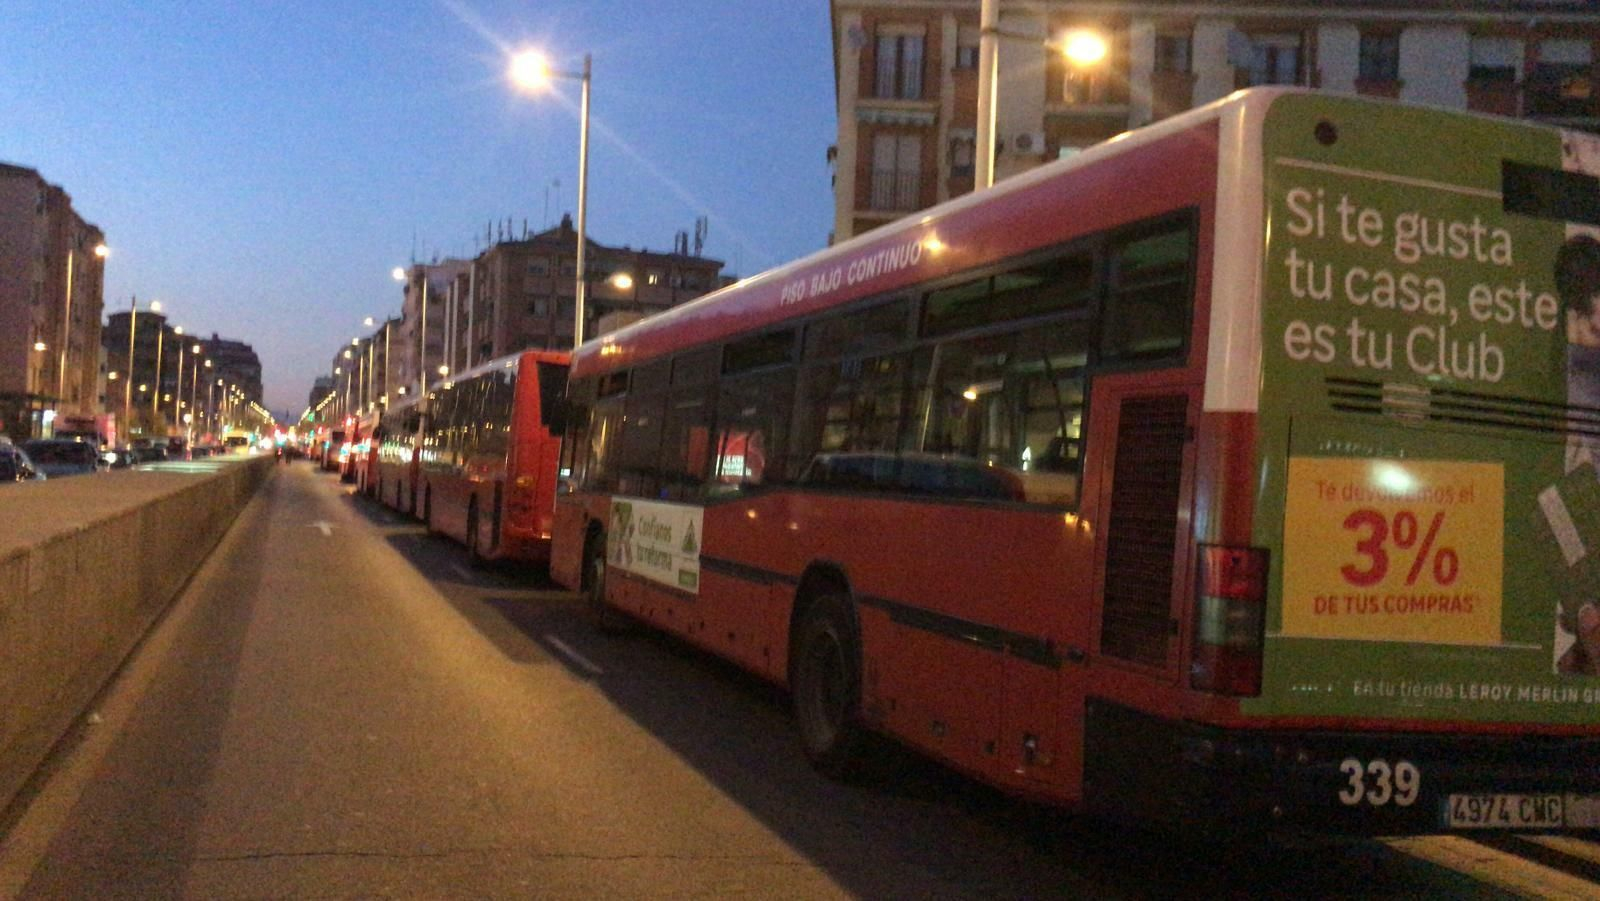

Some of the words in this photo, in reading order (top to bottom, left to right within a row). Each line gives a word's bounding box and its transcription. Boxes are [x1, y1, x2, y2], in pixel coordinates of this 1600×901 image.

[1286, 187, 1325, 238] Si
[1336, 193, 1383, 246] te
[1394, 211, 1514, 266] gusta
[780, 281, 806, 306] PISO
[811, 268, 842, 297] BAJO
[847, 240, 922, 286] CONTINUO
[1284, 247, 1332, 301] tu
[1344, 265, 1458, 326] casa,
[1468, 279, 1558, 331] este
[1283, 319, 1336, 363] es
[1346, 317, 1393, 371] tu
[1406, 324, 1505, 383] Club
[1339, 508, 1460, 588] 3%
[1313, 594, 1338, 615] DE
[1344, 594, 1379, 615] TUS
[1400, 680, 1453, 699] tienda
[1460, 683, 1512, 701] LEROY
[1518, 685, 1579, 703] MERLIN
[1338, 758, 1421, 807] 339
[1453, 797, 1510, 822] 4974
